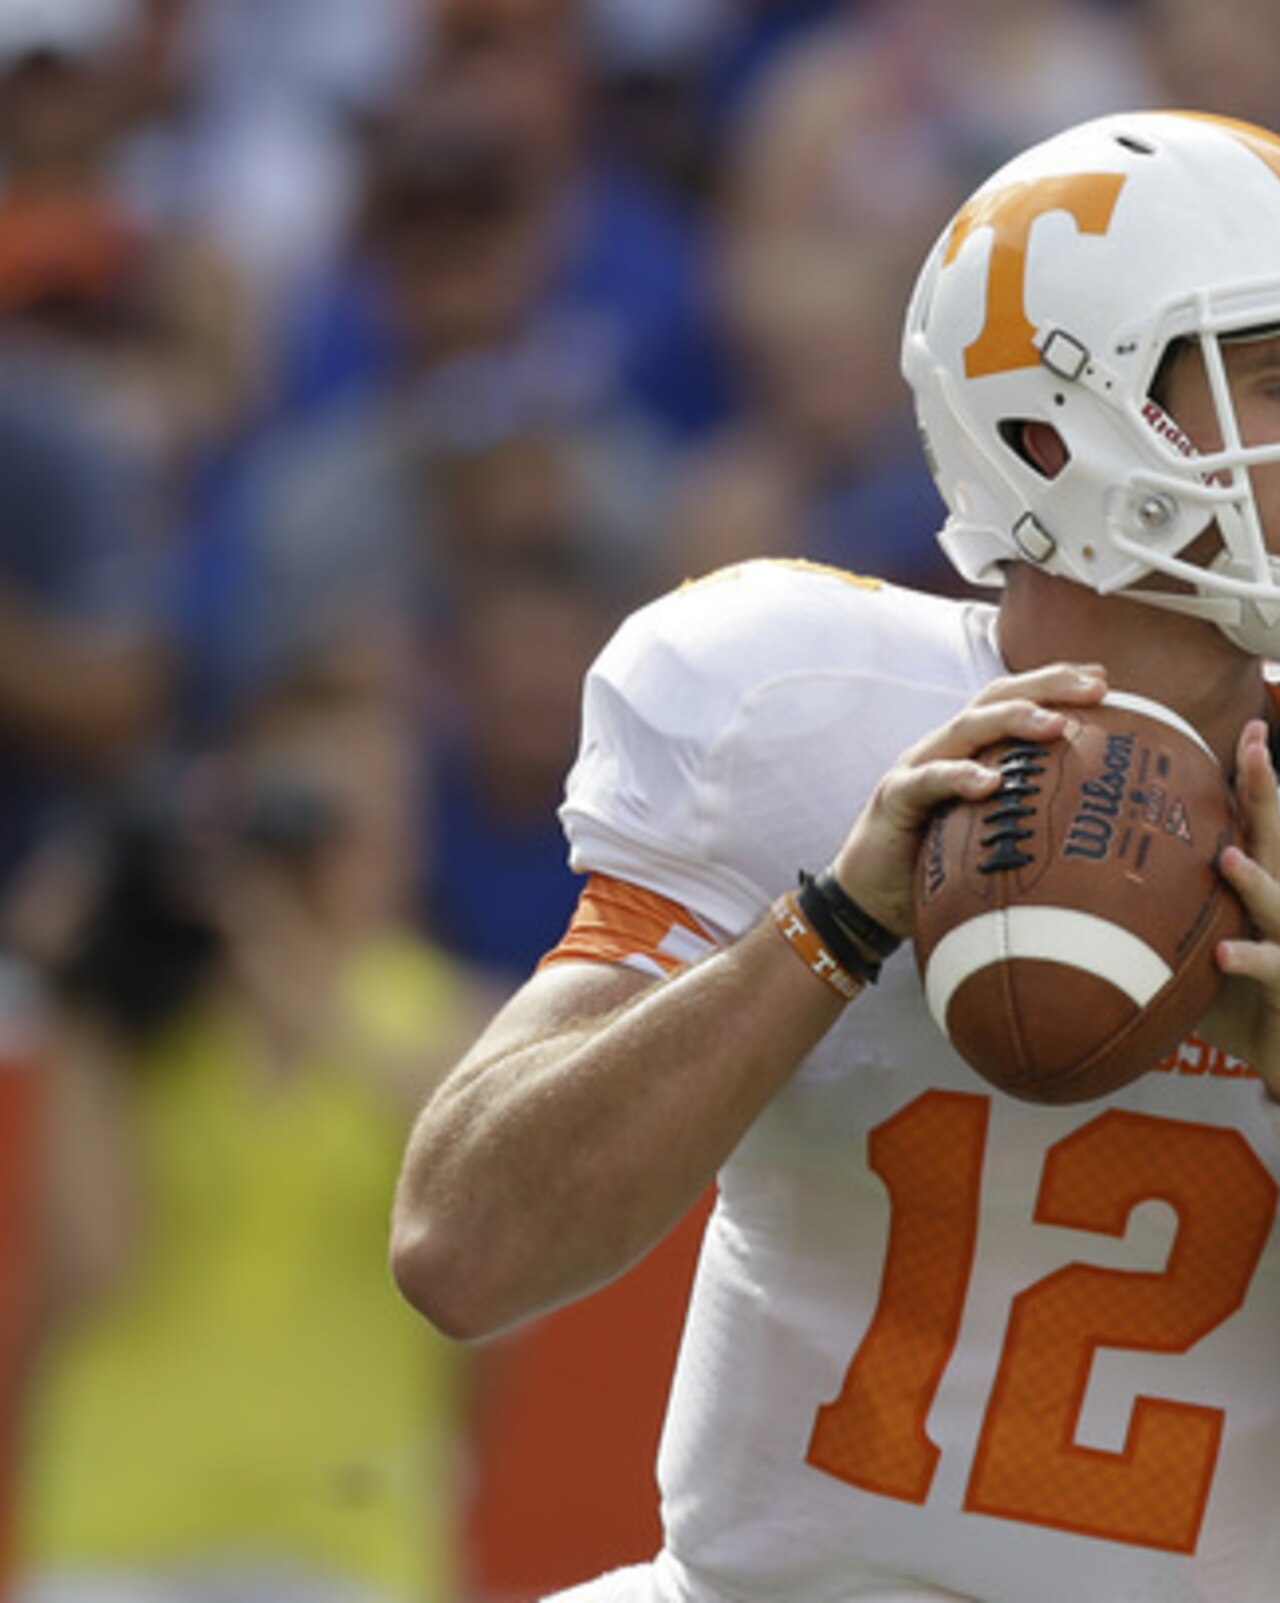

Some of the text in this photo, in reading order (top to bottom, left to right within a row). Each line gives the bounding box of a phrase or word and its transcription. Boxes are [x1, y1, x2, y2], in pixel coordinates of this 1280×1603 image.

[941, 172, 1127, 379] T
[1064, 733, 1134, 861] Wilson
[805, 1087, 1280, 1556] 12
